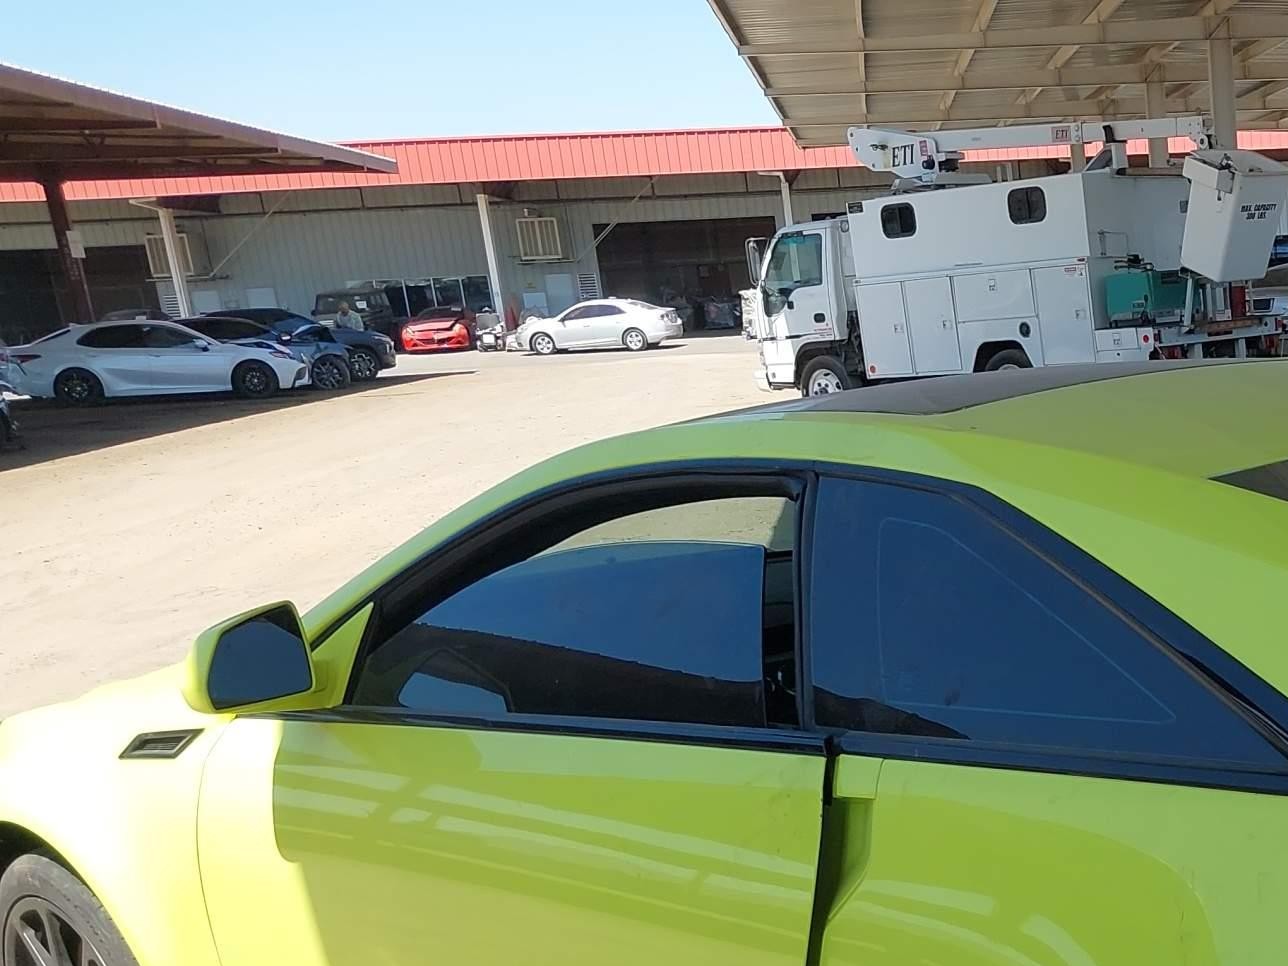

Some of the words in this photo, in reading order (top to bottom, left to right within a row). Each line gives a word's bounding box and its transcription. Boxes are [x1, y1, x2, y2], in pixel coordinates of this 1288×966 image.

[1055, 129, 1068, 139] ETI
[891, 143, 915, 167] ETI
[1254, 203, 1277, 211] CAPACITY
